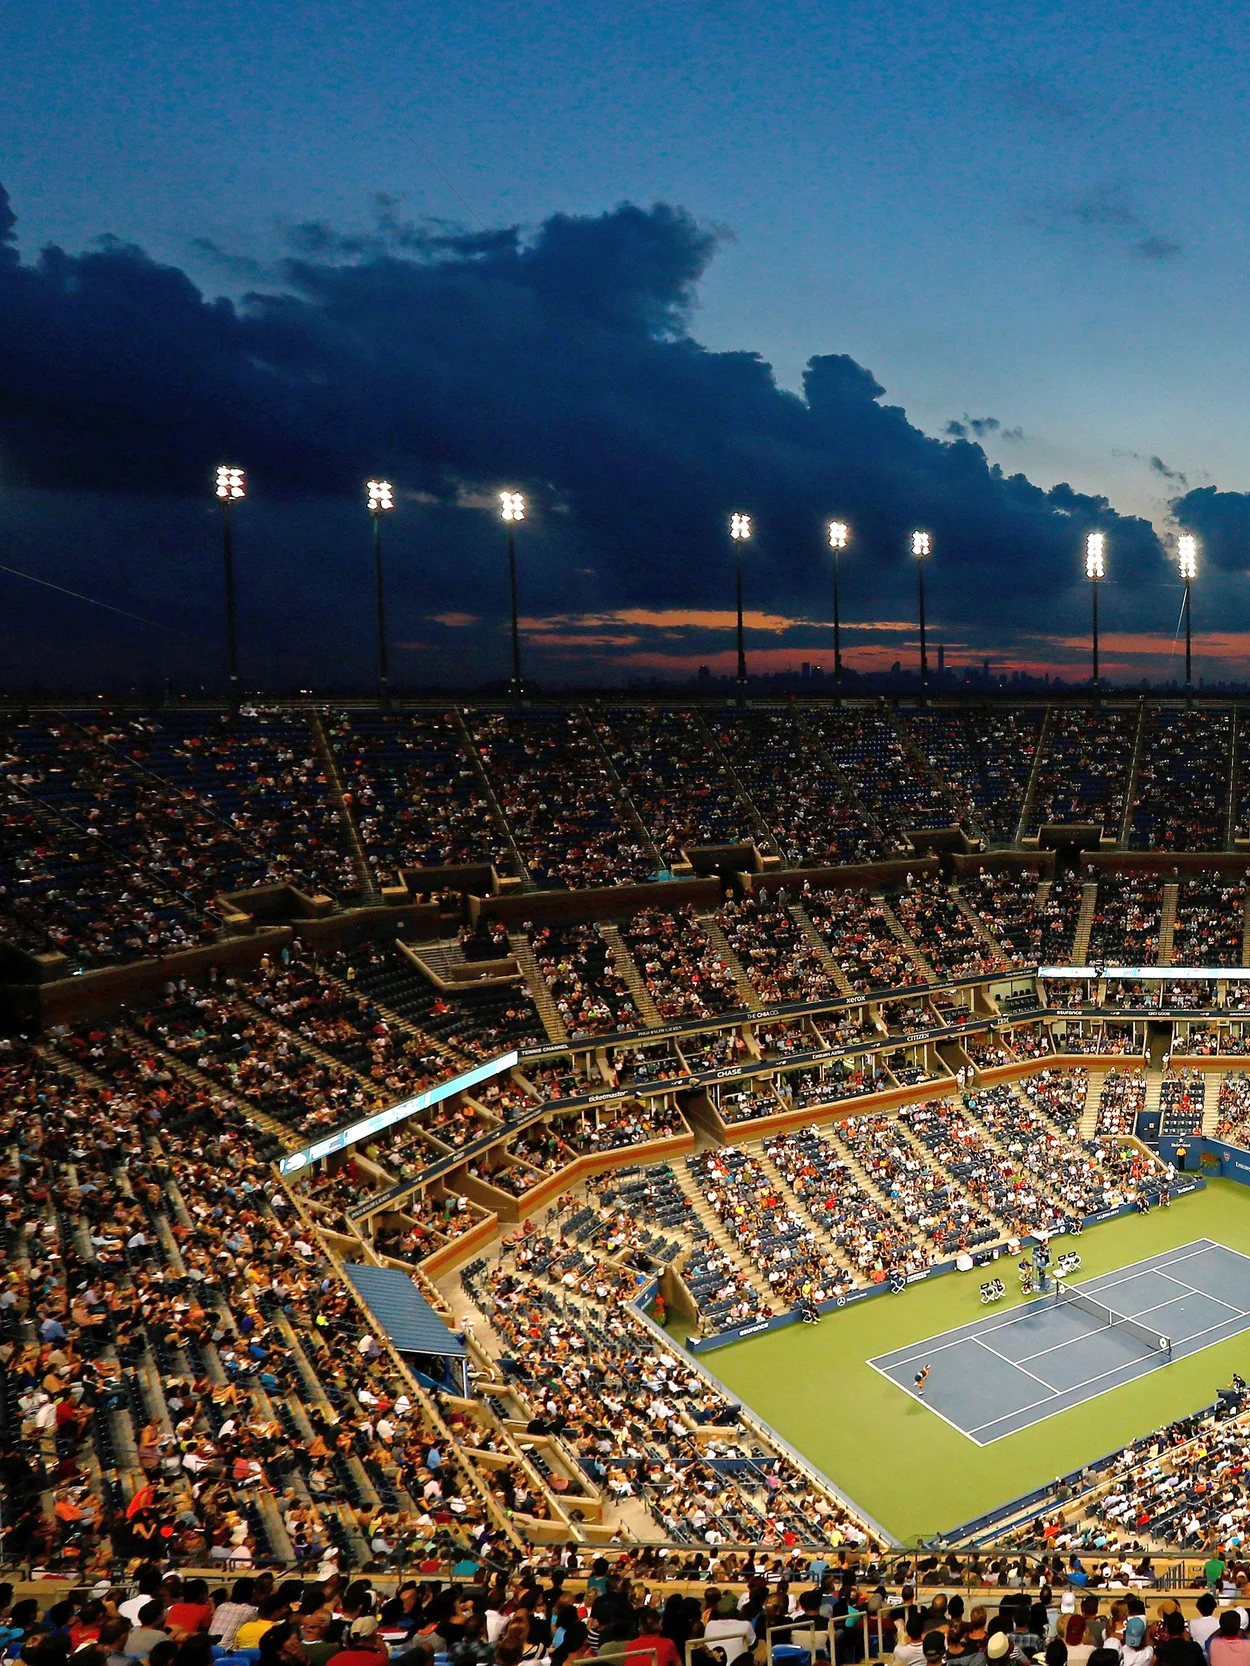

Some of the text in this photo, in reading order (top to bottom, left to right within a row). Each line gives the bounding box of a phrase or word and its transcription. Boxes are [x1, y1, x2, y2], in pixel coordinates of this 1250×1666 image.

[846, 996, 866, 1004] xerox
[906, 1033, 929, 1042] CITIZEN
[521, 1044, 569, 1056] TENNIS CHANNEL
[717, 1068, 742, 1078] CHASE
[589, 1090, 626, 1102] ticketmaster
[740, 1322, 768, 1336] esurance
